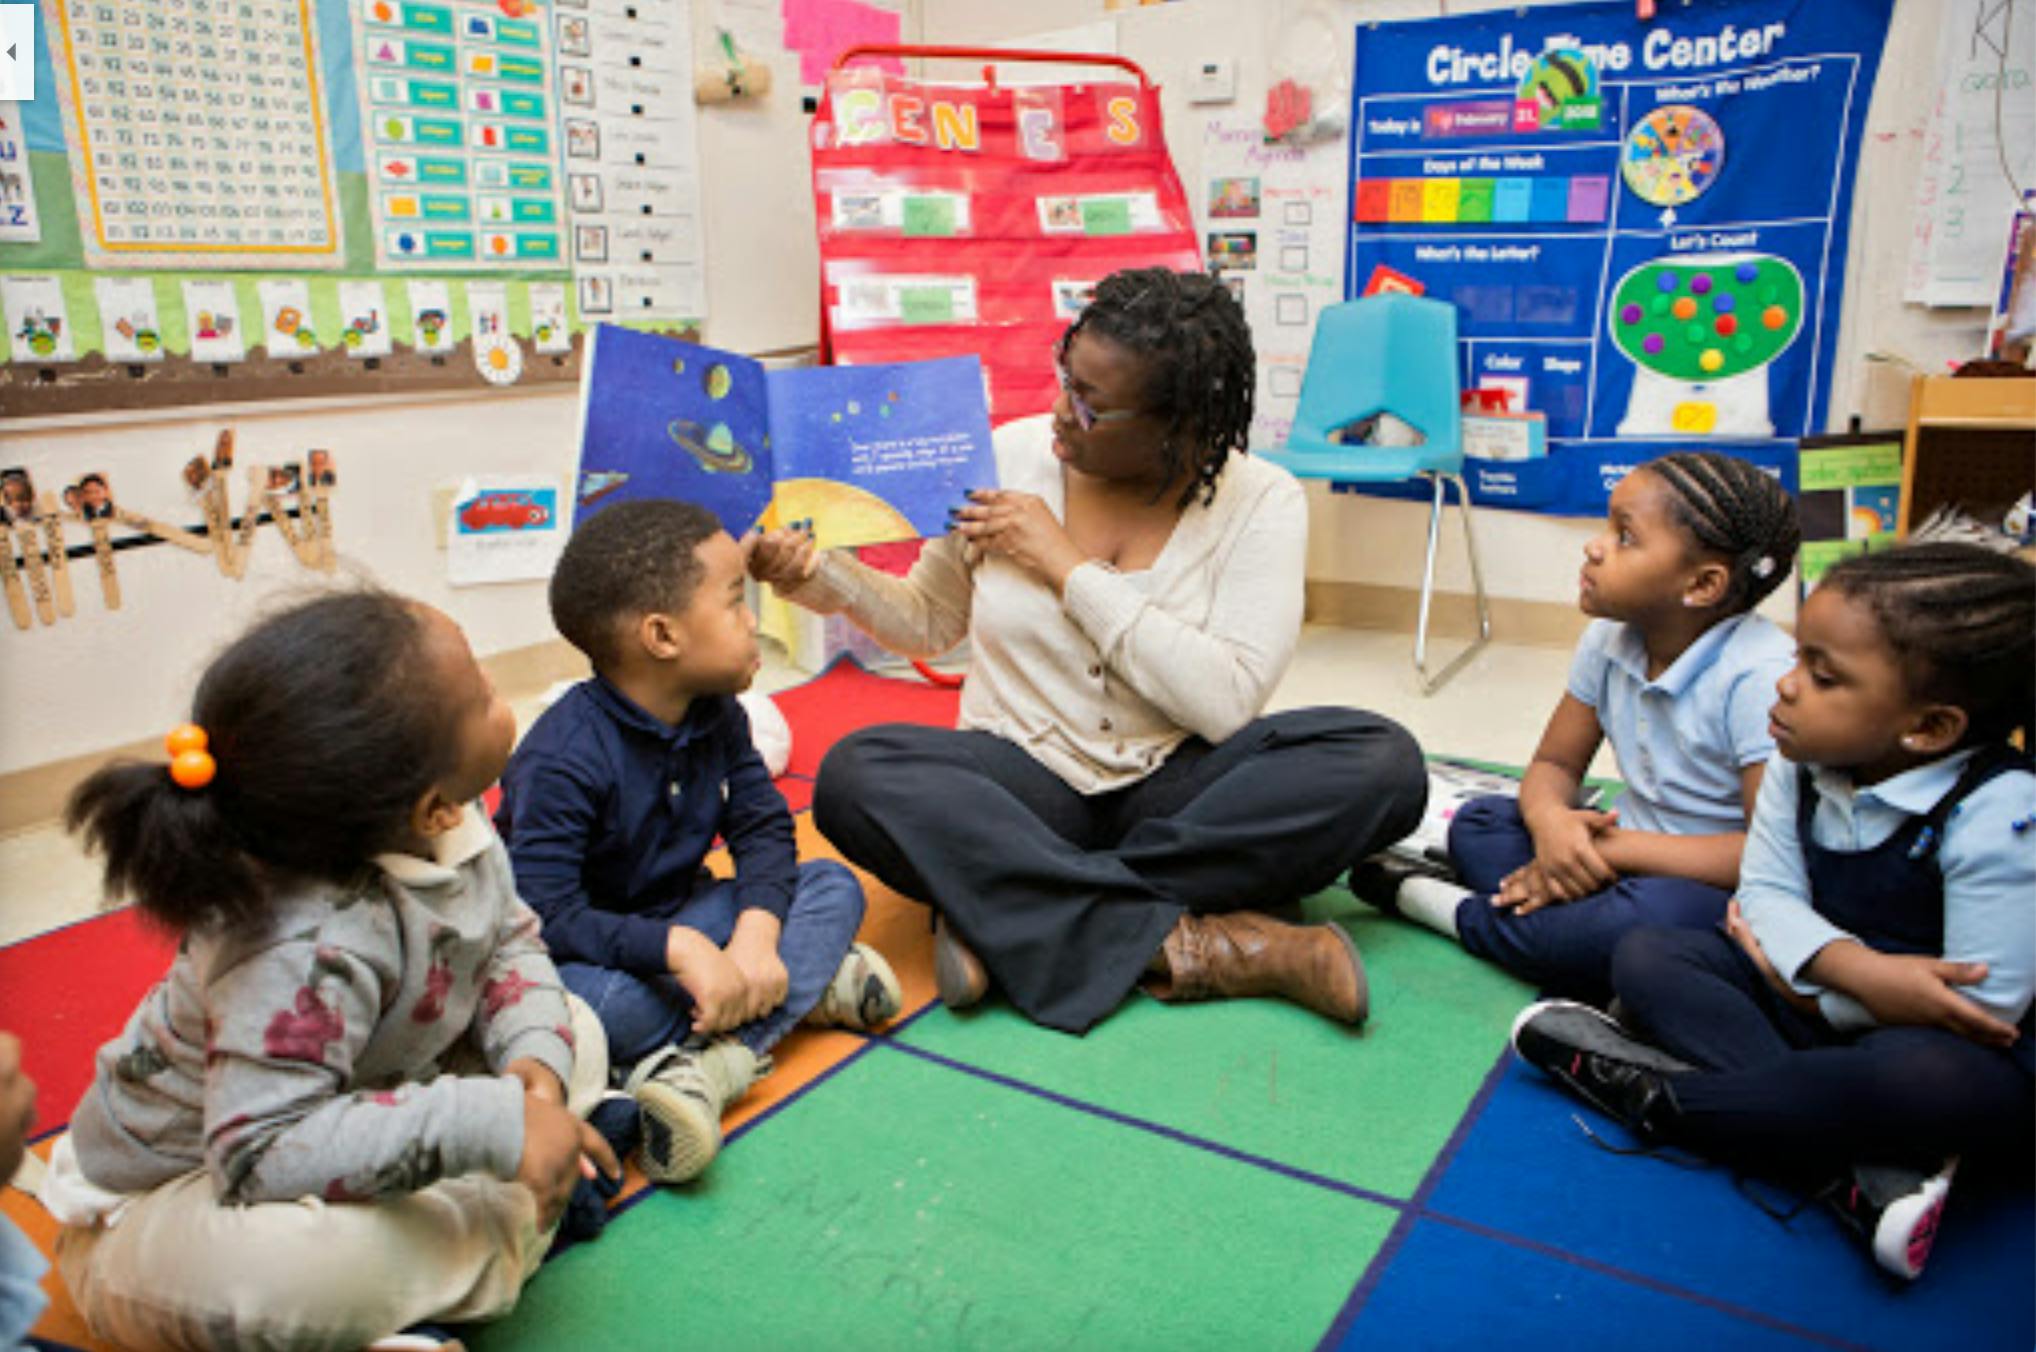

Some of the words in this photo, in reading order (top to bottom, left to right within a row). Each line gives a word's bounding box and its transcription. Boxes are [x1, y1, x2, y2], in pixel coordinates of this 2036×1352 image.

[1428, 34, 1528, 83] Circle
[1644, 21, 1785, 69] Center
[1105, 96, 1142, 145] S
